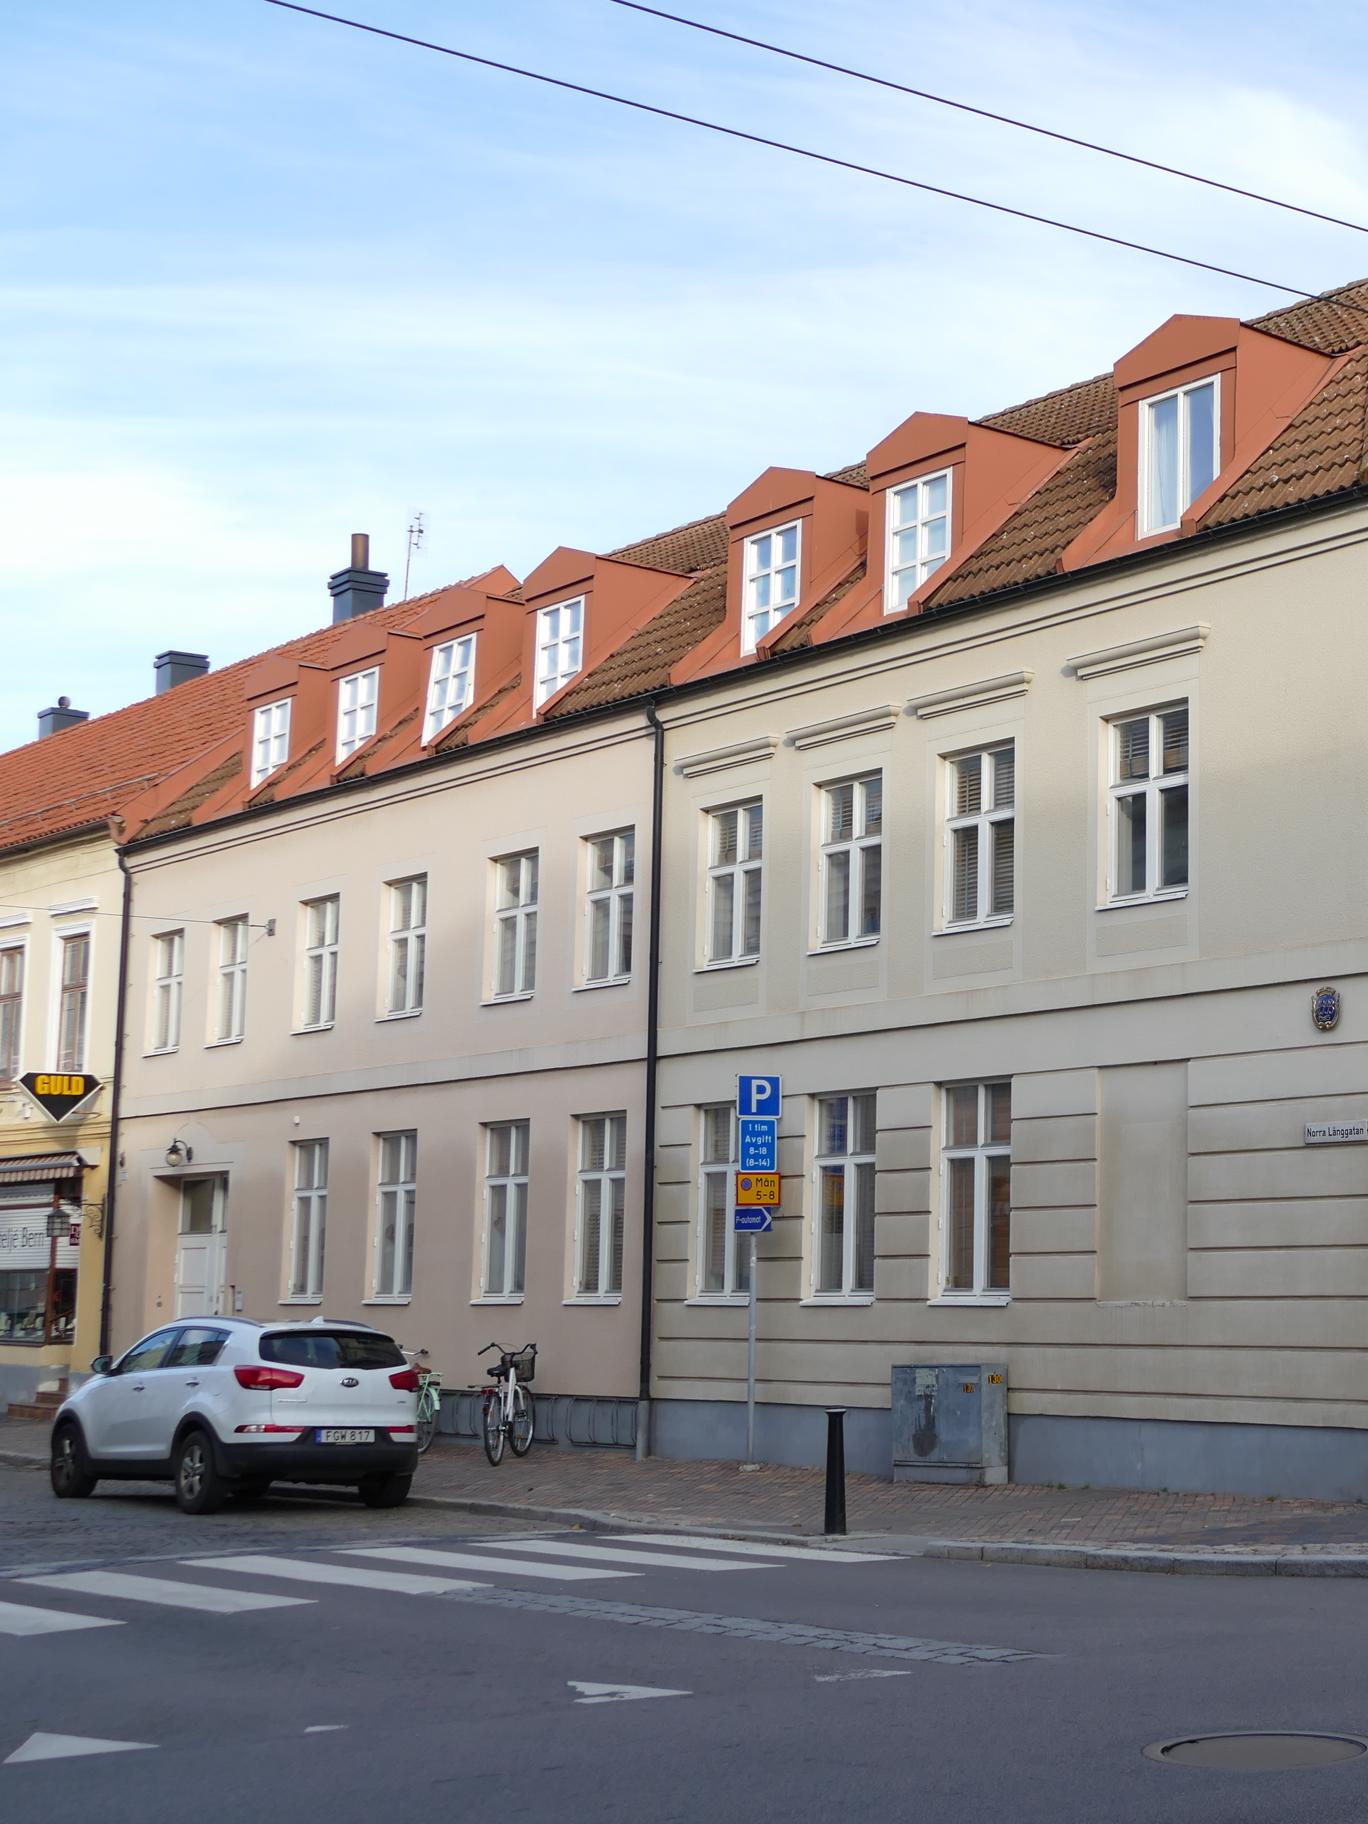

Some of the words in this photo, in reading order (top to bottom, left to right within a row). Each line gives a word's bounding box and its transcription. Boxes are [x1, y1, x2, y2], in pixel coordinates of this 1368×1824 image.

[35, 1074, 85, 1096] GULD
[751, 1079, 772, 1113] P
[755, 1123, 768, 1131] tim
[1307, 1127, 1326, 1137] Norra
[1328, 1126, 1364, 1138] Långgatan
[744, 1135, 772, 1144] Avgift
[748, 1146, 768, 1155] 8-18
[745, 1158, 770, 1167] (8-14)
[755, 1176, 776, 1188] Mån
[756, 1190, 776, 1200] 5-8
[735, 1215, 761, 1224] P-automat
[325, 1430, 346, 1441] FGW
[349, 1430, 370, 1441] 817
